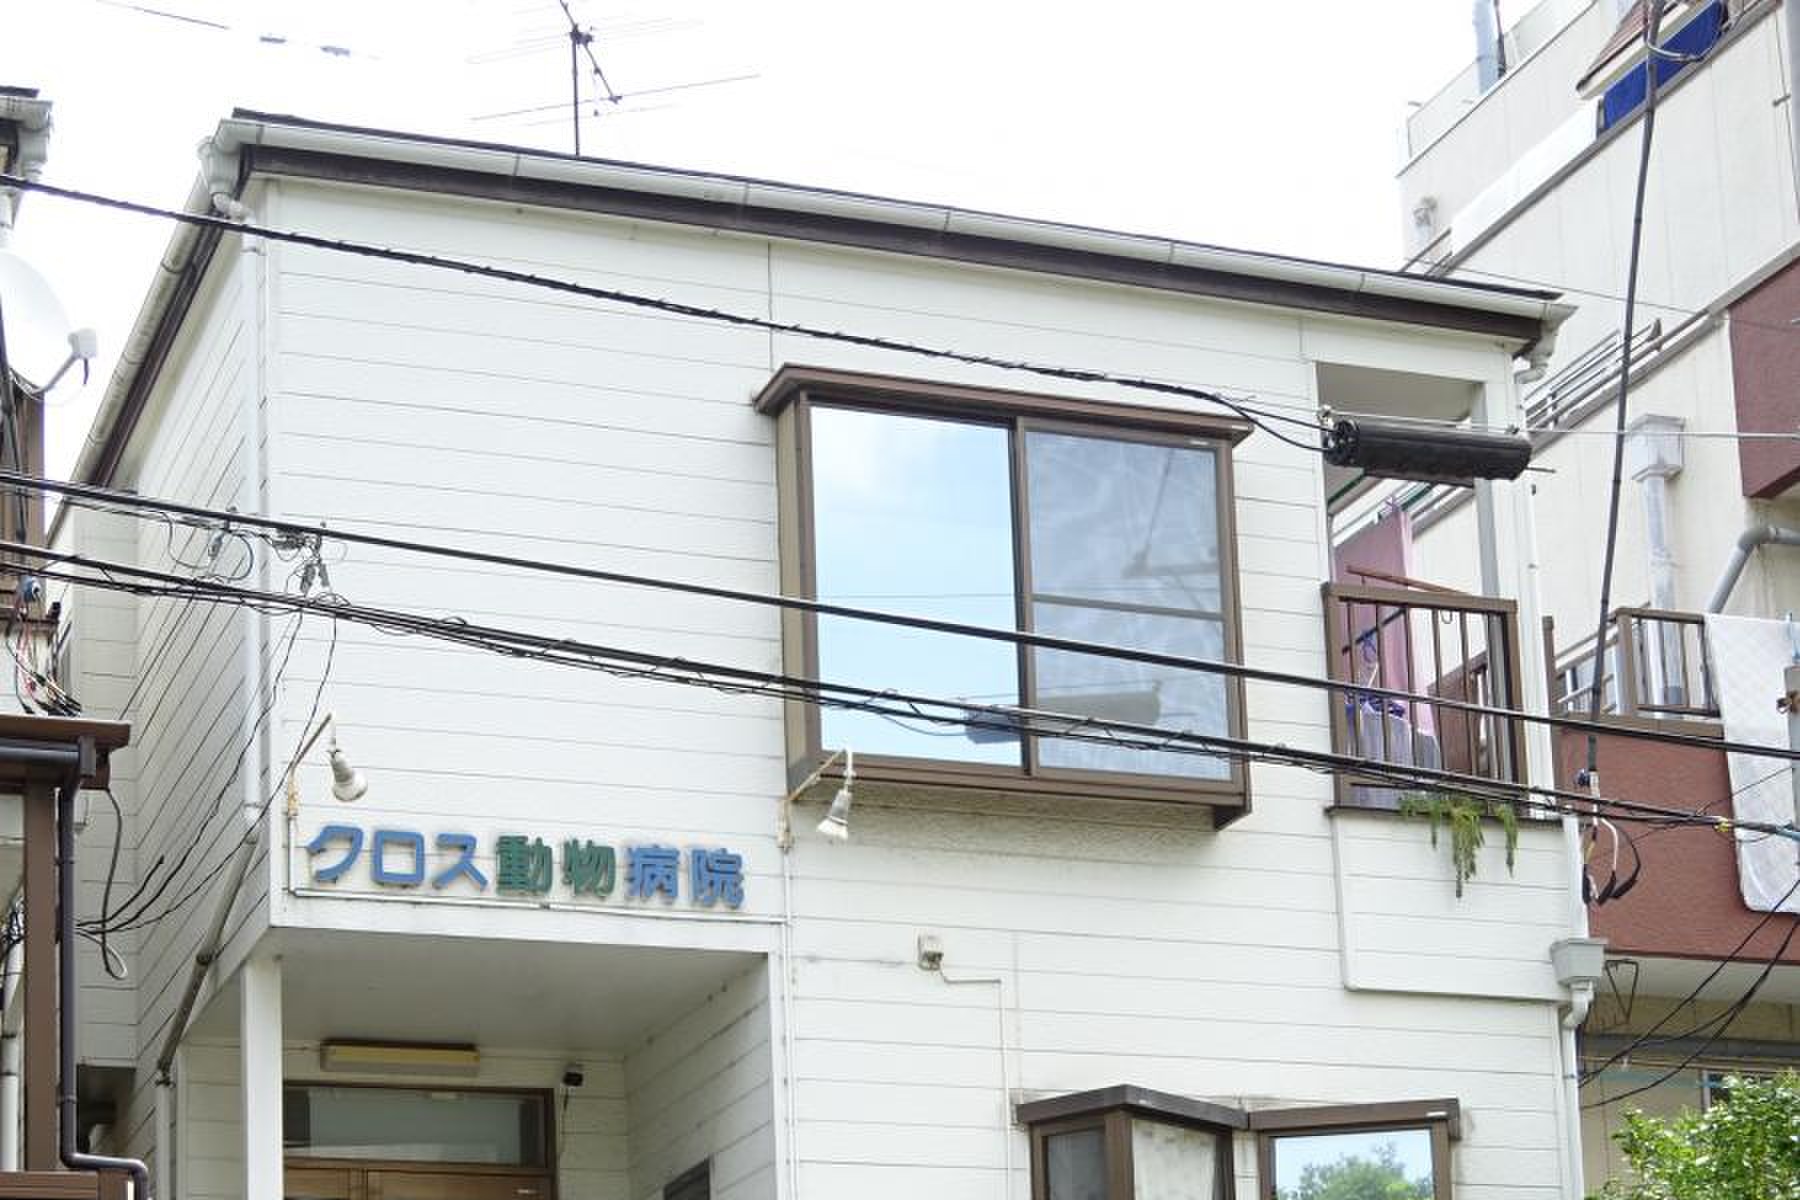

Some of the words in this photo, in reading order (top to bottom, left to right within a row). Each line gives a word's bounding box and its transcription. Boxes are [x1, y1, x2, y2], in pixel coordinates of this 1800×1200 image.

[306, 824, 746, 909] クロス動物病院
